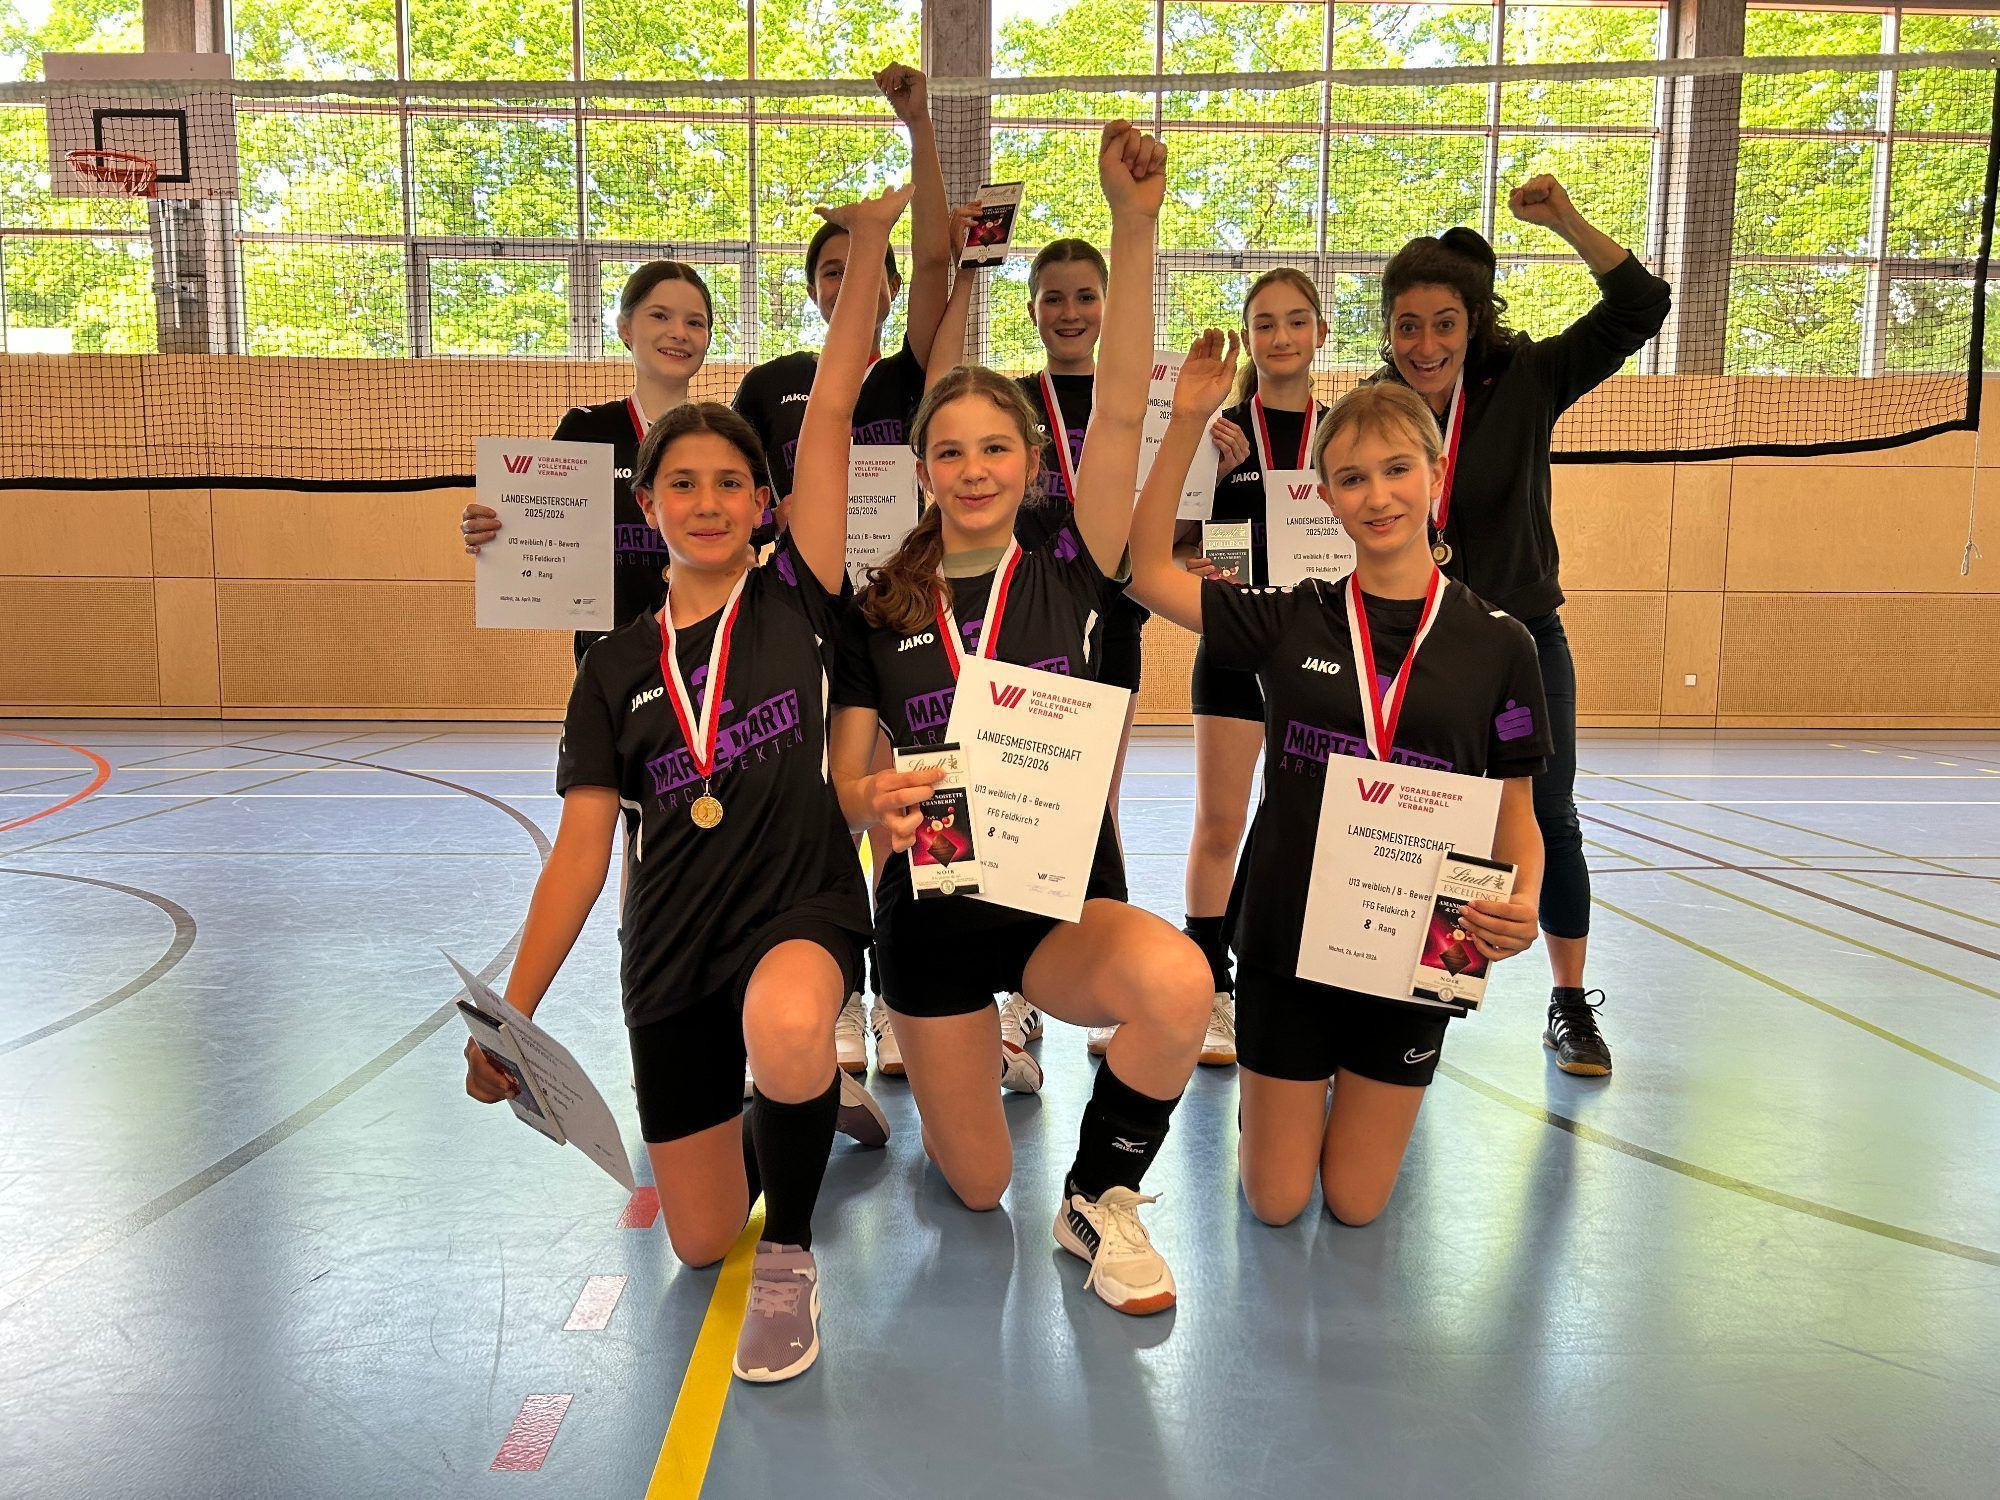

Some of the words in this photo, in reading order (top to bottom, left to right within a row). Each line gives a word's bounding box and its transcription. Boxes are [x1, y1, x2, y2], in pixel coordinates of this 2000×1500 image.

[781, 393, 809, 404] JAKO
[538, 456, 588, 465] VORARLBERGER
[538, 463, 579, 471] VOLLEYBALL
[614, 467, 633, 479] KO
[1230, 471, 1260, 484] JAKO
[501, 494, 588, 507] LANDESMEISTERSCHAFT
[848, 496, 897, 504] MEISTERSCHAFT
[525, 508, 565, 519] 2025/2026
[847, 507, 878, 516] 025/2026
[1286, 516, 1342, 526] LANDESMEISTERS
[1305, 527, 1339, 537] 2025/2026
[539, 571, 553, 579] Rang
[898, 632, 935, 652] JAKO
[1301, 656, 1341, 675] JAKO
[631, 686, 664, 713] JAKO
[1030, 698, 1079, 715] VOLLEYBALL
[1032, 690, 1092, 709] VORARLBERGER
[1028, 706, 1064, 720] VERBAND
[976, 729, 1082, 762] LANDESMEISTERSCHAFT
[1001, 751, 1049, 772] 2025/2026
[974, 784, 986, 794] U13
[988, 788, 1016, 801] weiblich
[1034, 797, 1060, 811] Bewerb
[1399, 793, 1450, 808] VOLLEYBALL
[1400, 785, 1463, 801] VORARLBERGER
[922, 798, 956, 807] CRANBERRY
[1397, 801, 1435, 814] VERBAND
[987, 808, 1000, 818] FFG
[1000, 810, 1033, 825] Feldkirch
[1034, 818, 1040, 827] 2
[988, 826, 996, 838] 8
[1001, 830, 1020, 844] Rang
[1347, 824, 1456, 853] LANDESMEISTERSCHAFT
[1373, 845, 1423, 865] 2025/2026
[1446, 866, 1494, 887] Lindt
[1348, 877, 1360, 887] U13
[1362, 881, 1391, 894] weiblich
[1409, 890, 1432, 902] Bewer
[1444, 884, 1500, 903] EXCELLENCE
[1362, 899, 1375, 910] FFG
[1376, 902, 1409, 918] Feldkirch
[1410, 910, 1416, 919] 2
[1363, 918, 1372, 930] 8
[1378, 923, 1396, 936] Rang
[1354, 950, 1364, 958] April
[1440, 976, 1460, 985] NOIR
